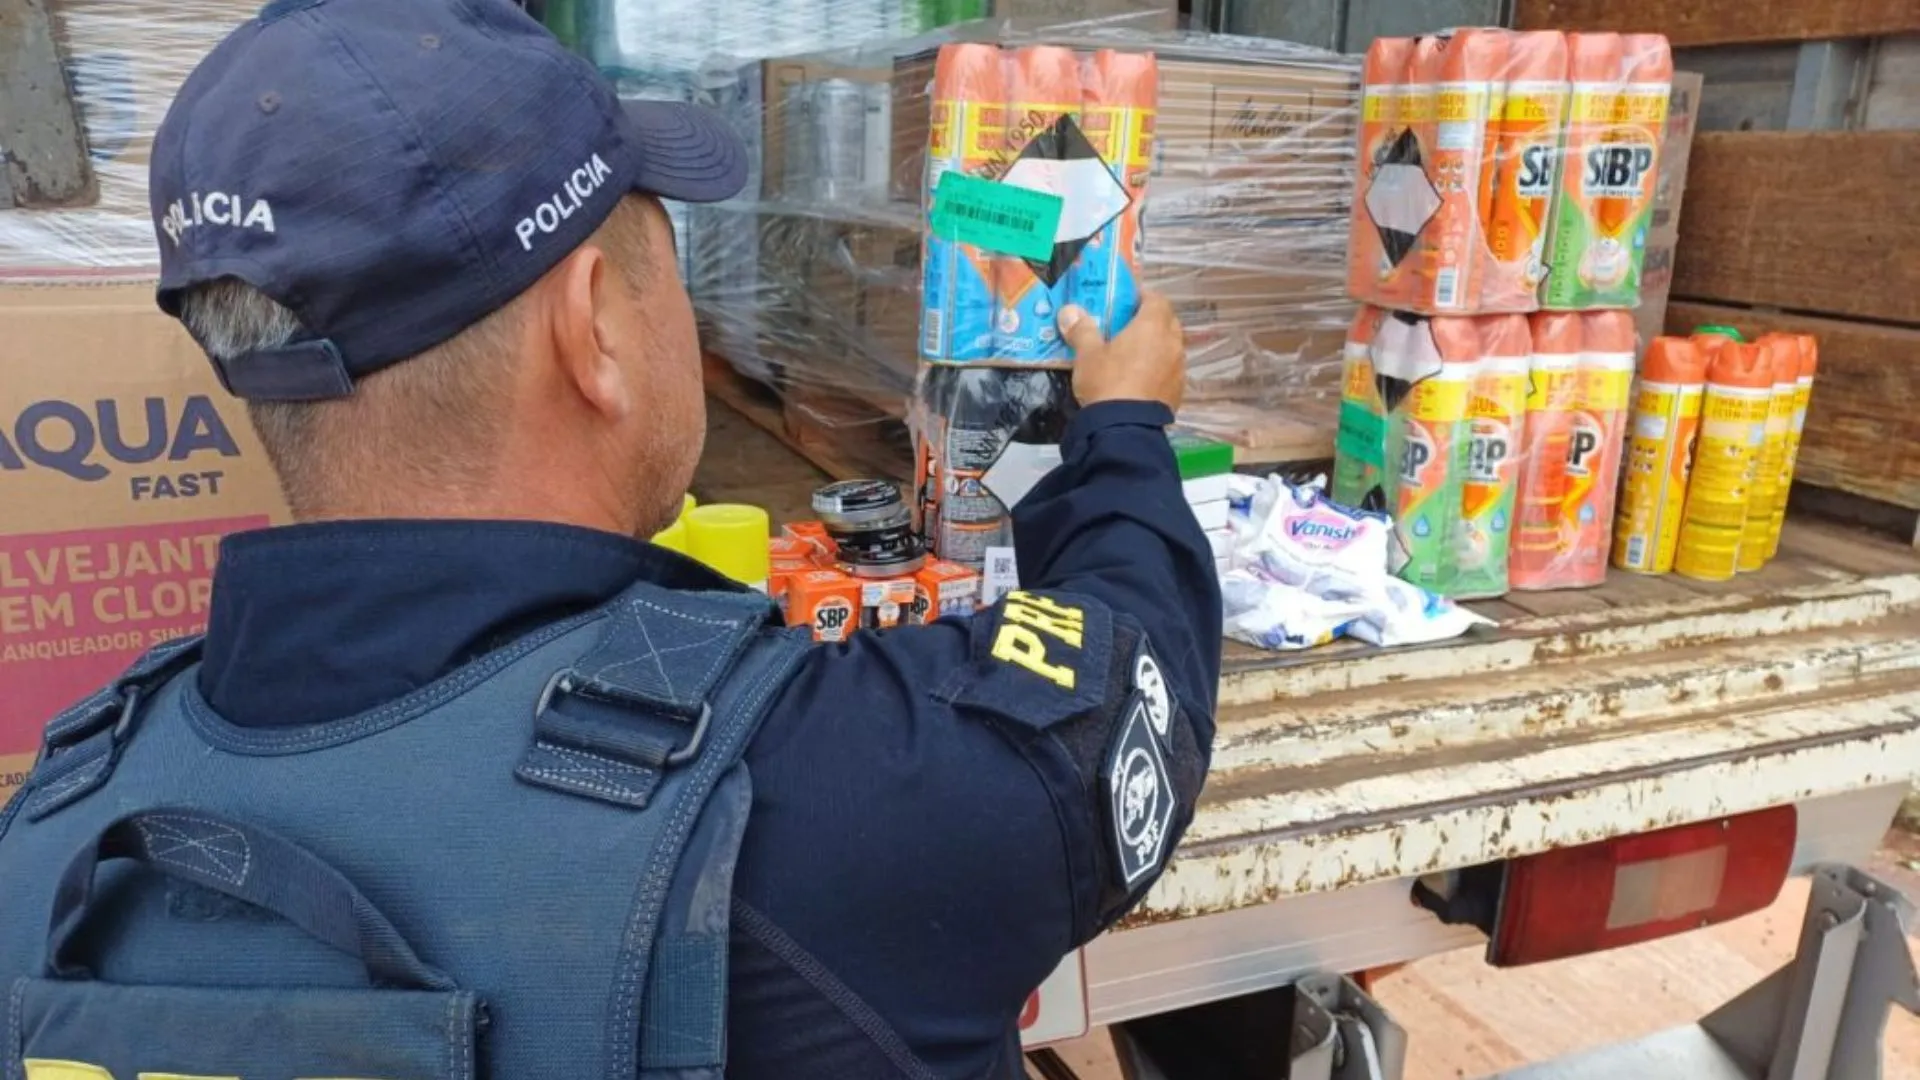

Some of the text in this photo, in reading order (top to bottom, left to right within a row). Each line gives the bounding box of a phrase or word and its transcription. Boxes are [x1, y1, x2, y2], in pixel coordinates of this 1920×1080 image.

[514, 152, 613, 251] POLICIA
[162, 191, 275, 247] POLICIA
[131, 471, 224, 500] FAST
[1292, 519, 1353, 540] Vanish
[817, 608, 848, 630] SBP
